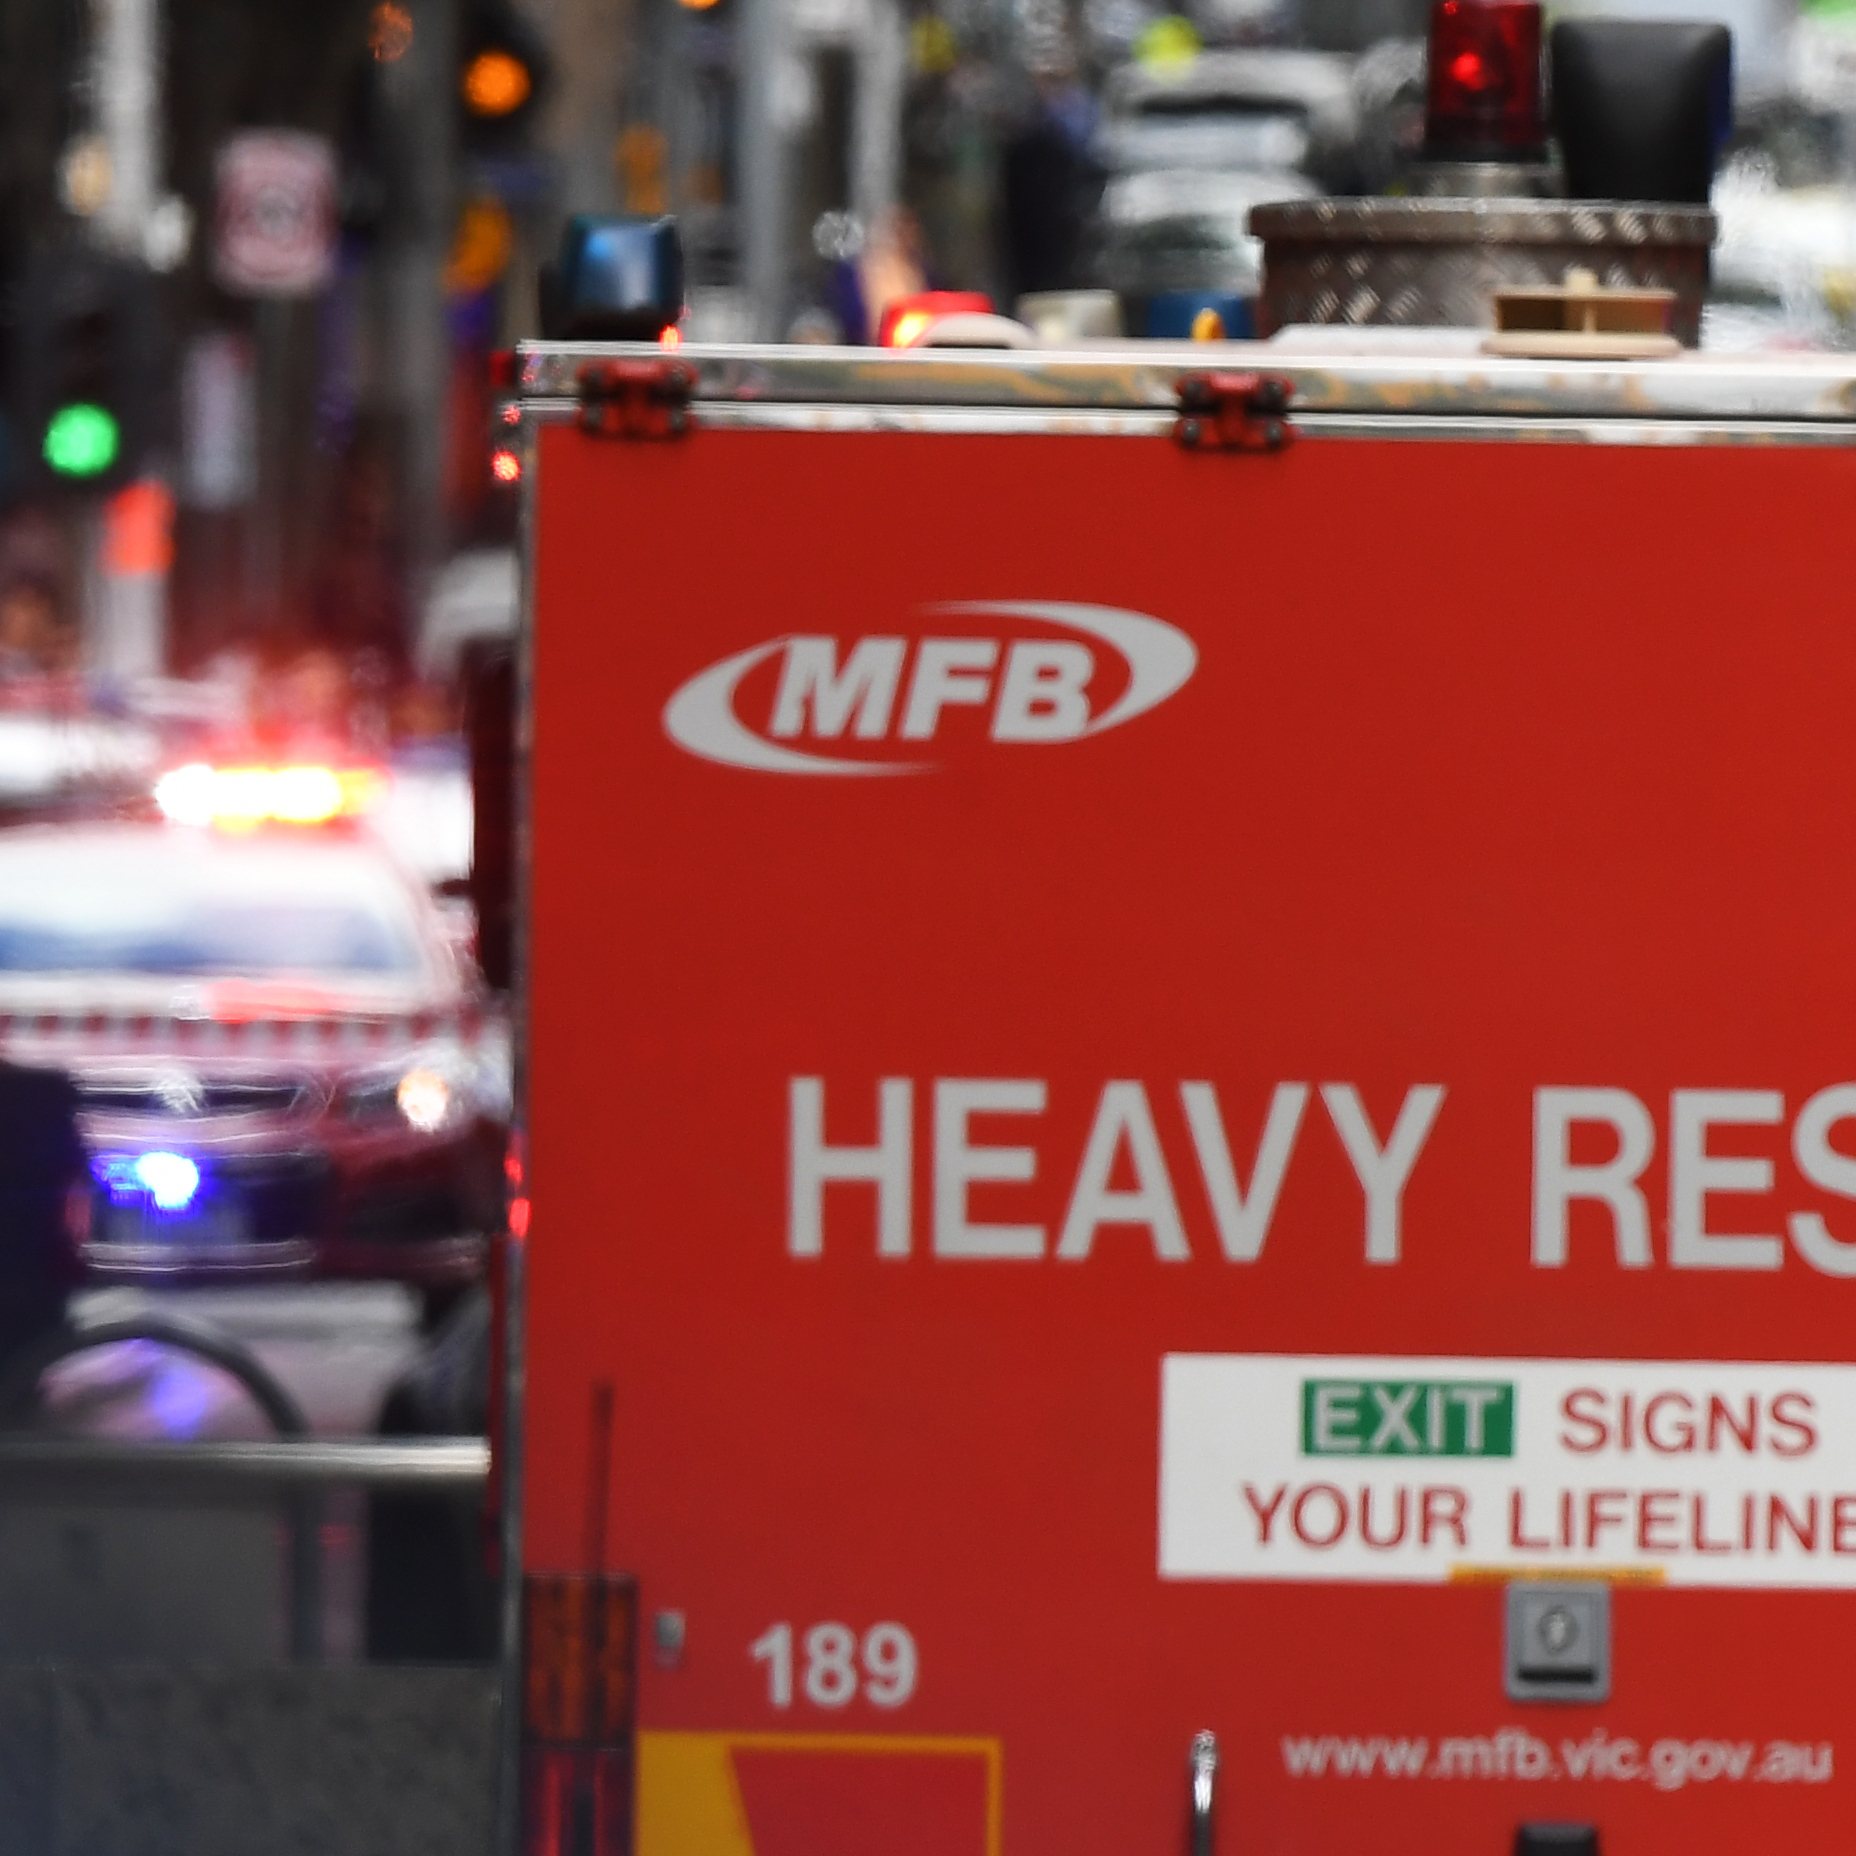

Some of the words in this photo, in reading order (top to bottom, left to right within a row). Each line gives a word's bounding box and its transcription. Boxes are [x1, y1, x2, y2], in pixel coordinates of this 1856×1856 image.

[767, 635, 1099, 743] MFB
[787, 1077, 1445, 1263] HEAVY
[1311, 1384, 1502, 1456] EXIT
[1558, 1387, 1819, 1458] SIGNS
[1242, 1483, 1469, 1551] YOUR
[752, 1623, 917, 1706] 189
[1284, 1732, 1833, 1785] www.mfb.vic.gov.au
